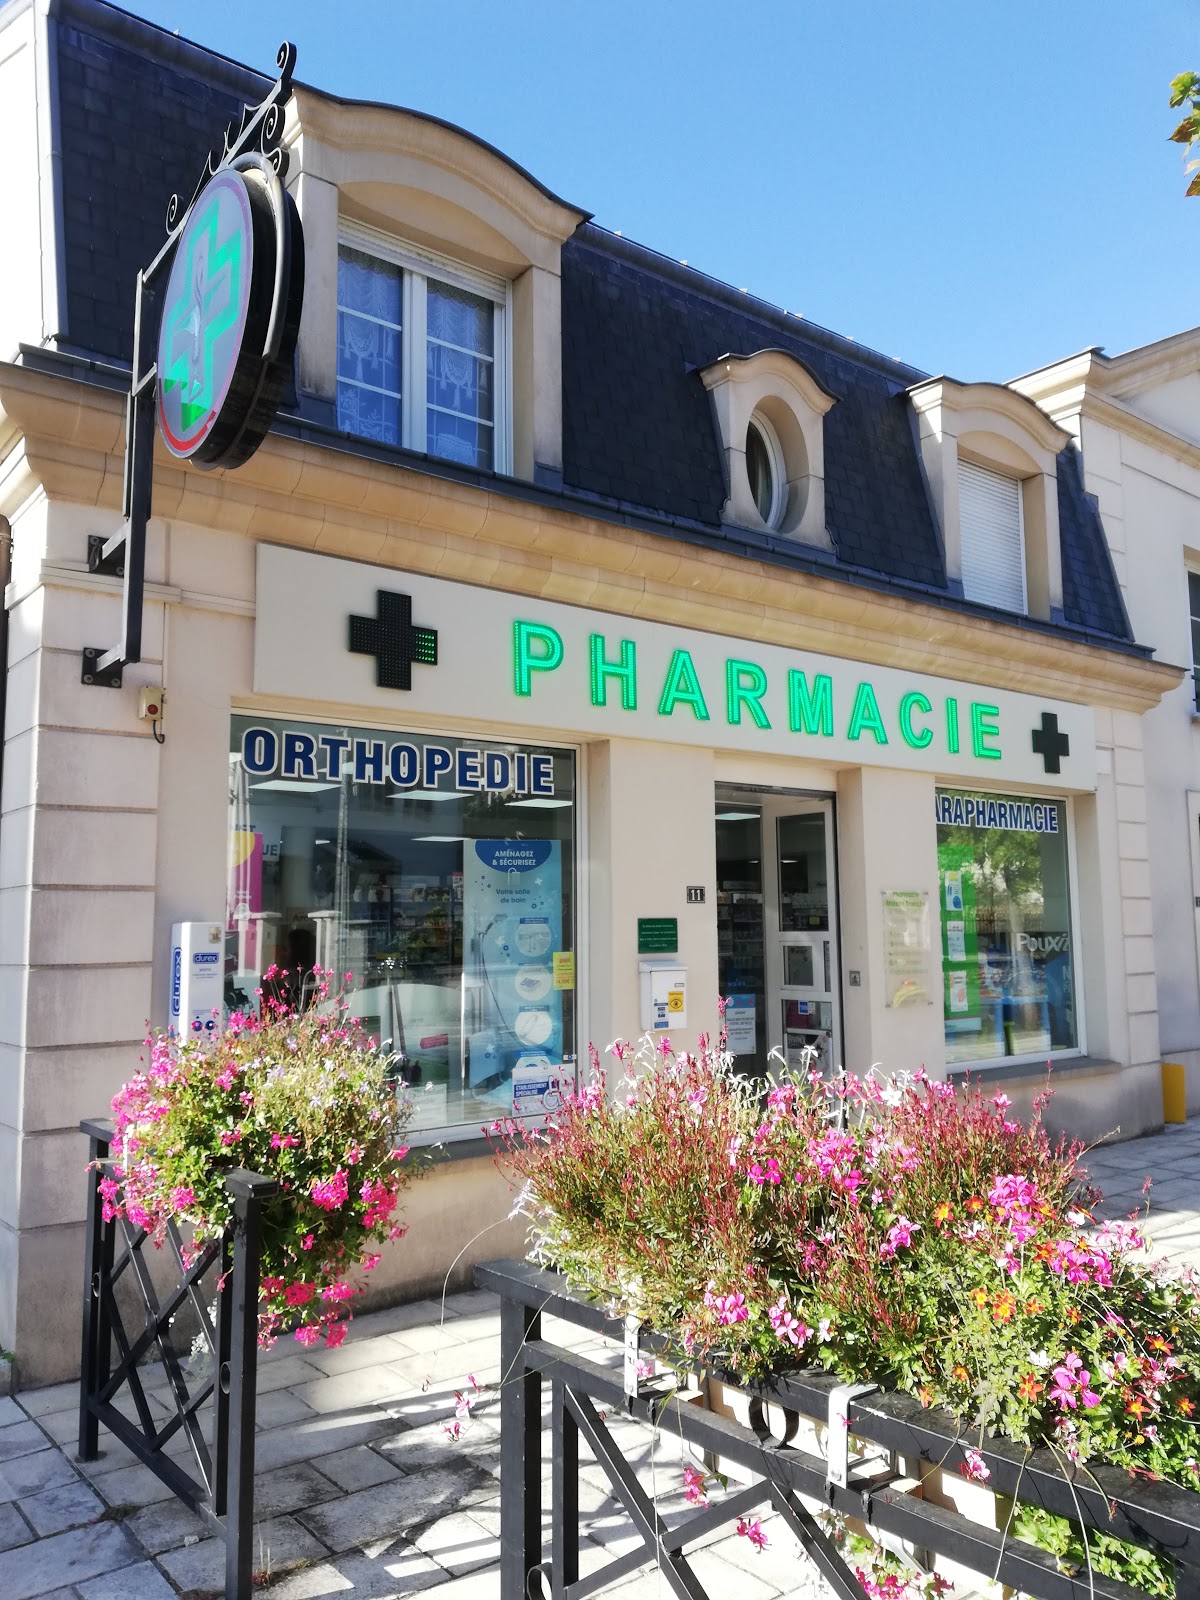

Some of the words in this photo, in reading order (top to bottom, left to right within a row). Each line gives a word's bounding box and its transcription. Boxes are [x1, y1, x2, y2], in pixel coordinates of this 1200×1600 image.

[513, 619, 1002, 761] PHARMACIE
[241, 727, 555, 796] ORTHOPEDIE
[494, 849, 534, 857] AMÉNAGEZ
[499, 858, 536, 866] SÉCURISEZ
[690, 889, 701, 901] 11
[194, 954, 218, 963] durex
[172, 954, 181, 1010] durex
